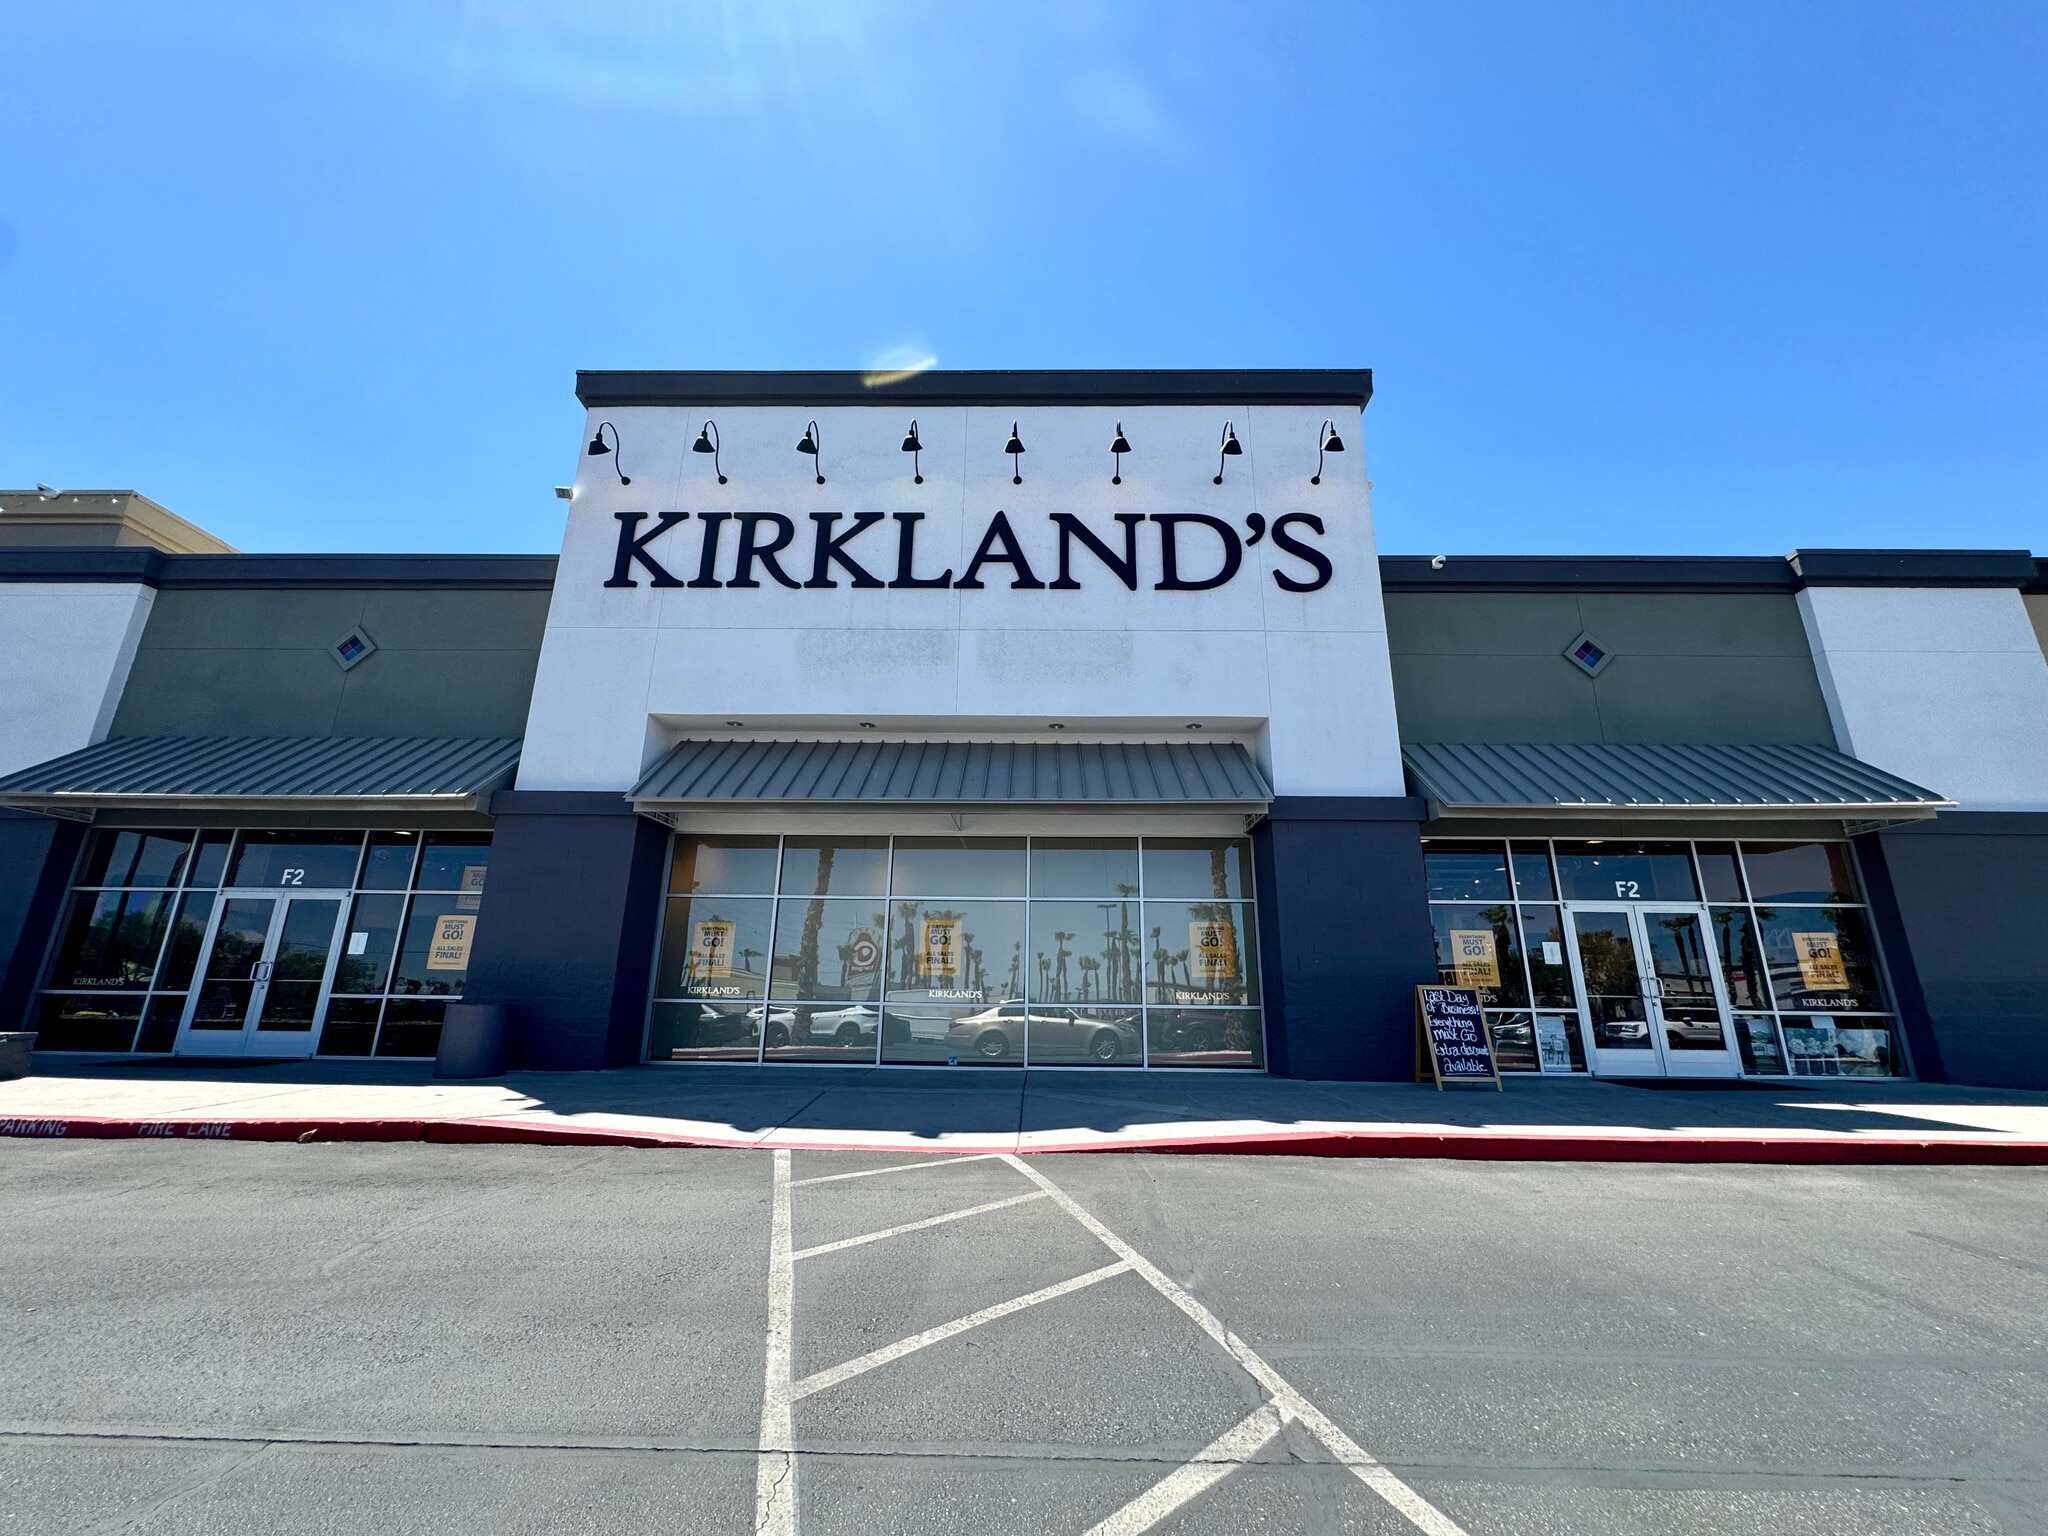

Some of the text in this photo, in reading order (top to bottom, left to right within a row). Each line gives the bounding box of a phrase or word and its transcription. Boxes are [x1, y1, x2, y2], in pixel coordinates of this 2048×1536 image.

[603, 511, 1334, 593] KIRKLAND'S
[281, 868, 305, 885] F2
[1615, 880, 1640, 898] F2
[442, 930, 463, 940] GO!
[930, 935, 951, 945] GO!
[703, 937, 724, 947] GO!
[1201, 937, 1223, 947] GO!
[1463, 945, 1485, 956] GO!
[1808, 948, 1831, 958] GO!
[698, 959, 725, 967] FINAL!
[73, 977, 124, 985] KIRKLAND'S
[687, 986, 740, 995] KIRKLAND'S
[929, 989, 982, 998] KIRKLAND'S
[1175, 991, 1230, 1000] KIRKLAND'S
[1424, 990, 1446, 1002] Last
[1444, 990, 1469, 1006] Day
[1802, 998, 1858, 1007] KIRKLAND'S
[1426, 1001, 1436, 1013] of
[1428, 1015, 1475, 1032] Everything
[1434, 1042, 1460, 1056] Extra
[187, 1122, 232, 1137] LANE
